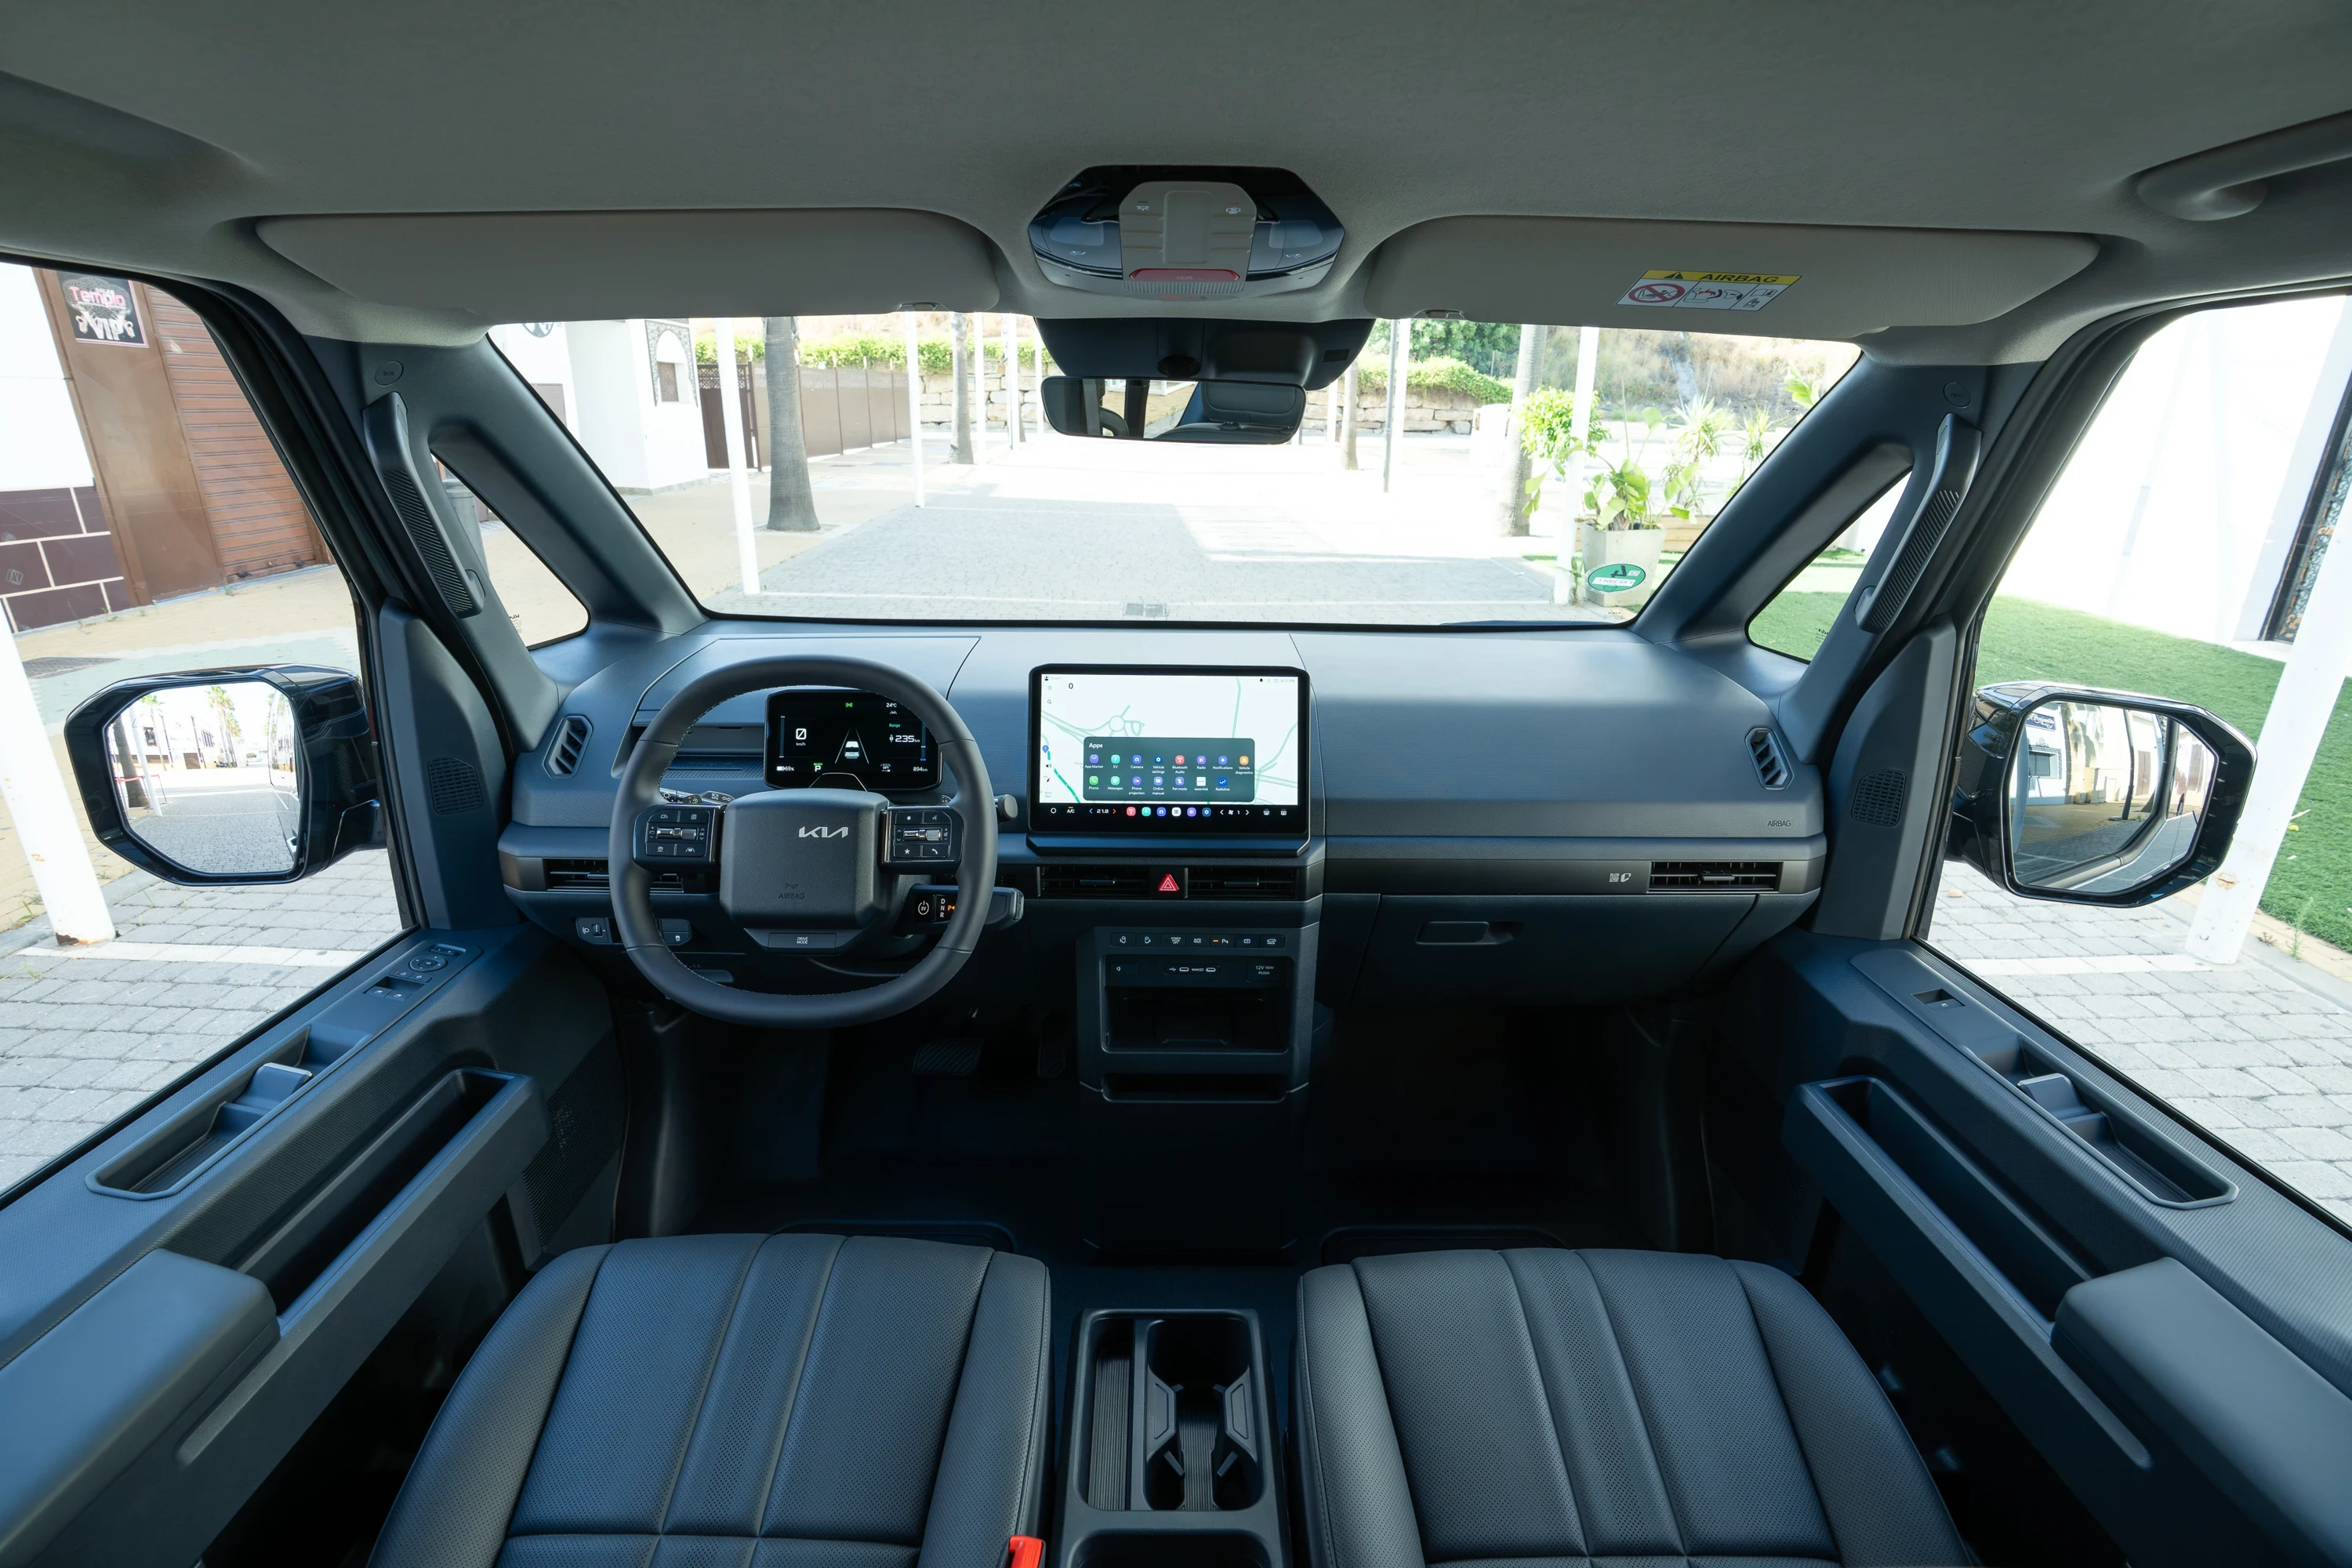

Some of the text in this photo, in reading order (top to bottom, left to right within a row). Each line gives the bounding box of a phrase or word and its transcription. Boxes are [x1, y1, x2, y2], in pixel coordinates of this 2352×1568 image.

[1699, 274, 1779, 283] AIRBAG
[68, 285, 126, 308] Templo
[81, 310, 125, 341] VIP
[796, 728, 807, 740] 0
[798, 826, 848, 838] KIA
[779, 892, 805, 901] AIRBAG
